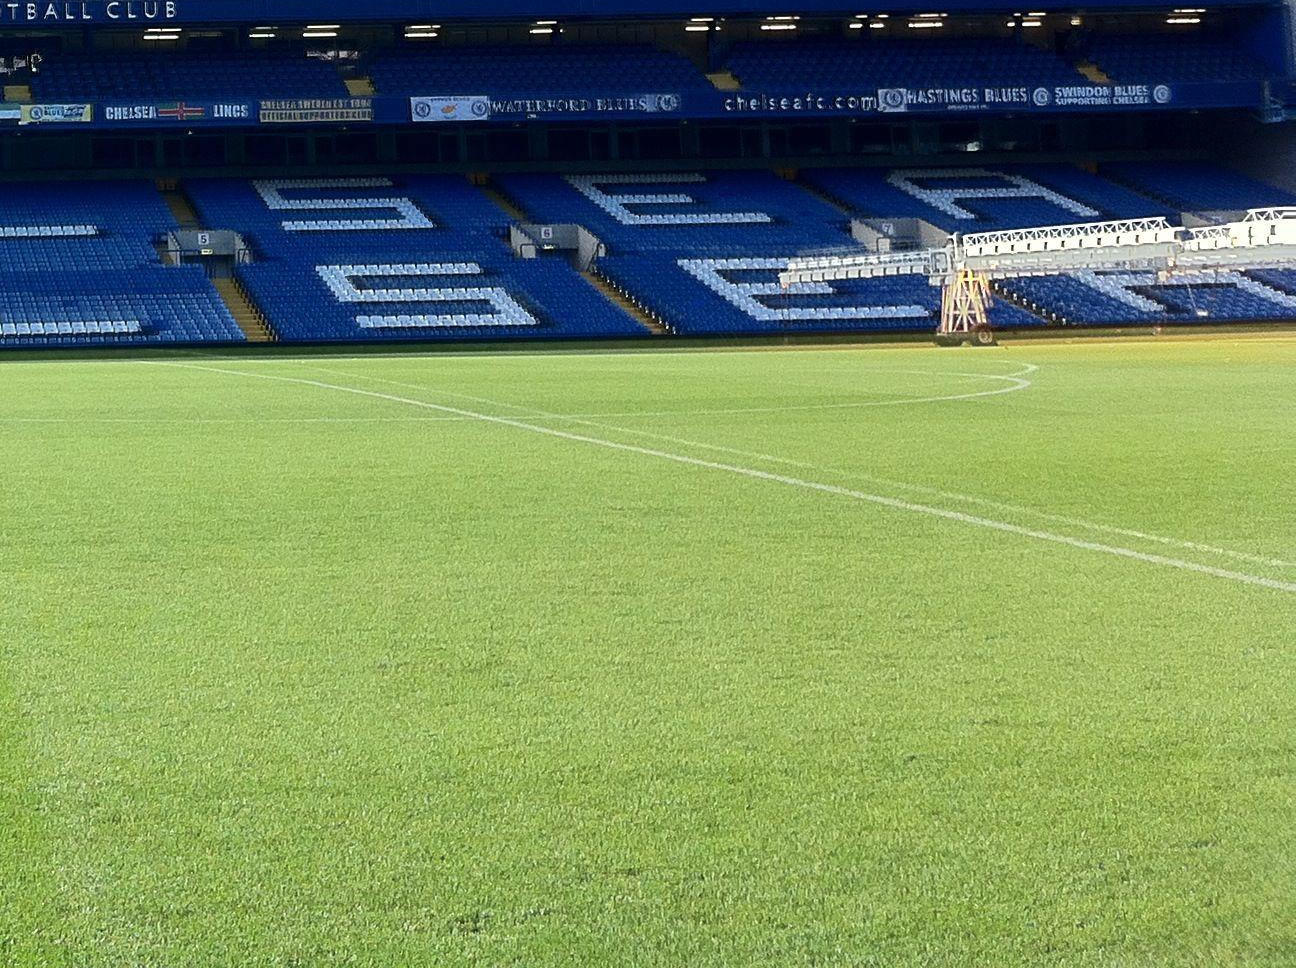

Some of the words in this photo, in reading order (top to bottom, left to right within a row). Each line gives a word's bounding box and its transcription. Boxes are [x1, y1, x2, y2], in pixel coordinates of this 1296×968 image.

[106, 1, 177, 19] CLUB
[907, 88, 977, 104] HASTINGS
[985, 87, 1028, 102] BLUES
[1054, 86, 1109, 98] SWINDON
[1113, 85, 1148, 96] BLUES
[489, 99, 588, 113] WATERFORD
[596, 97, 647, 111] BLUES
[724, 92, 877, 111] chelseafc.com
[106, 106, 157, 119] CHELSEA
